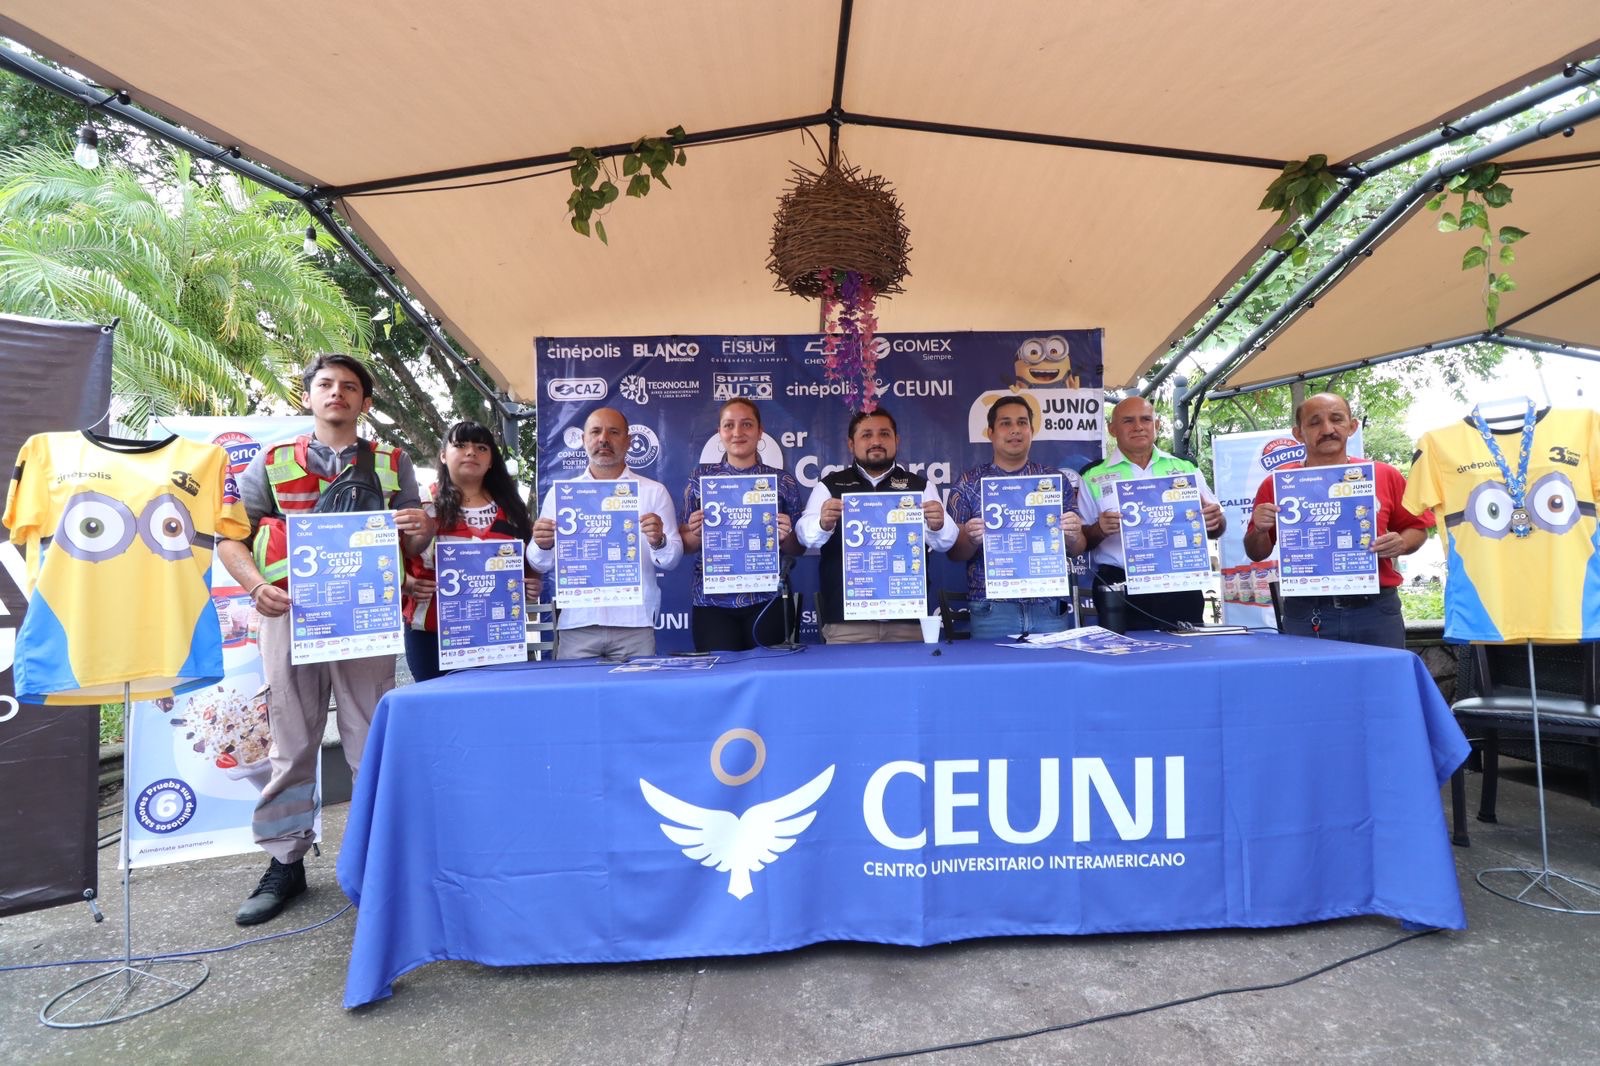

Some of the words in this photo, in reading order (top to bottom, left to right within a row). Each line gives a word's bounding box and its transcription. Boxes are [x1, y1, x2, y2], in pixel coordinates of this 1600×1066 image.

[547, 343, 621, 360] cinépolis
[633, 343, 699, 359] BLANCO
[575, 384, 600, 394] CAZ
[647, 381, 699, 389] TECKNOCLIM
[893, 380, 952, 396] CEUNI
[1042, 398, 1099, 414] JUNIO
[1044, 418, 1072, 430] 8:00
[1077, 418, 1097, 430] AM
[781, 431, 807, 448] er
[1267, 440, 1292, 450] CALIDAD
[230, 448, 258, 461] eno
[1264, 449, 1304, 467] Bueno
[1549, 446, 1565, 462] 3
[57, 471, 111, 484] cinépolis
[796, 455, 950, 488] Cara
[171, 471, 188, 490] 3
[746, 493, 760, 503] 30
[1167, 490, 1180, 501] 30
[1333, 484, 1352, 496] 30
[606, 498, 620, 509] 30
[1029, 494, 1044, 504] 30
[704, 502, 721, 527] 3
[891, 512, 905, 522] 30
[986, 503, 1003, 529] 3
[1122, 502, 1141, 527] 3
[1279, 497, 1301, 524] 3
[558, 508, 577, 535] 3
[355, 533, 374, 545] 30
[846, 520, 864, 547] 3
[292, 546, 318, 577] 3
[320, 551, 362, 560] Carrera
[329, 557, 362, 566] CEUNI
[489, 559, 504, 570] 30
[440, 569, 460, 596] 3
[653, 613, 689, 630] UNI
[146, 781, 180, 796] Prueba
[180, 787, 192, 801] sus
[156, 794, 177, 817] 6
[863, 756, 1185, 849] CEUNI
[139, 795, 154, 828] sabores
[156, 802, 194, 831] deliciosos
[139, 845, 176, 854] Aliméntate
[177, 840, 214, 849] sanamente
[864, 860, 927, 878] CENTRO
[931, 855, 1044, 875] UNIVERSITARIO
[1049, 852, 1185, 871] INTERAMERICANO
